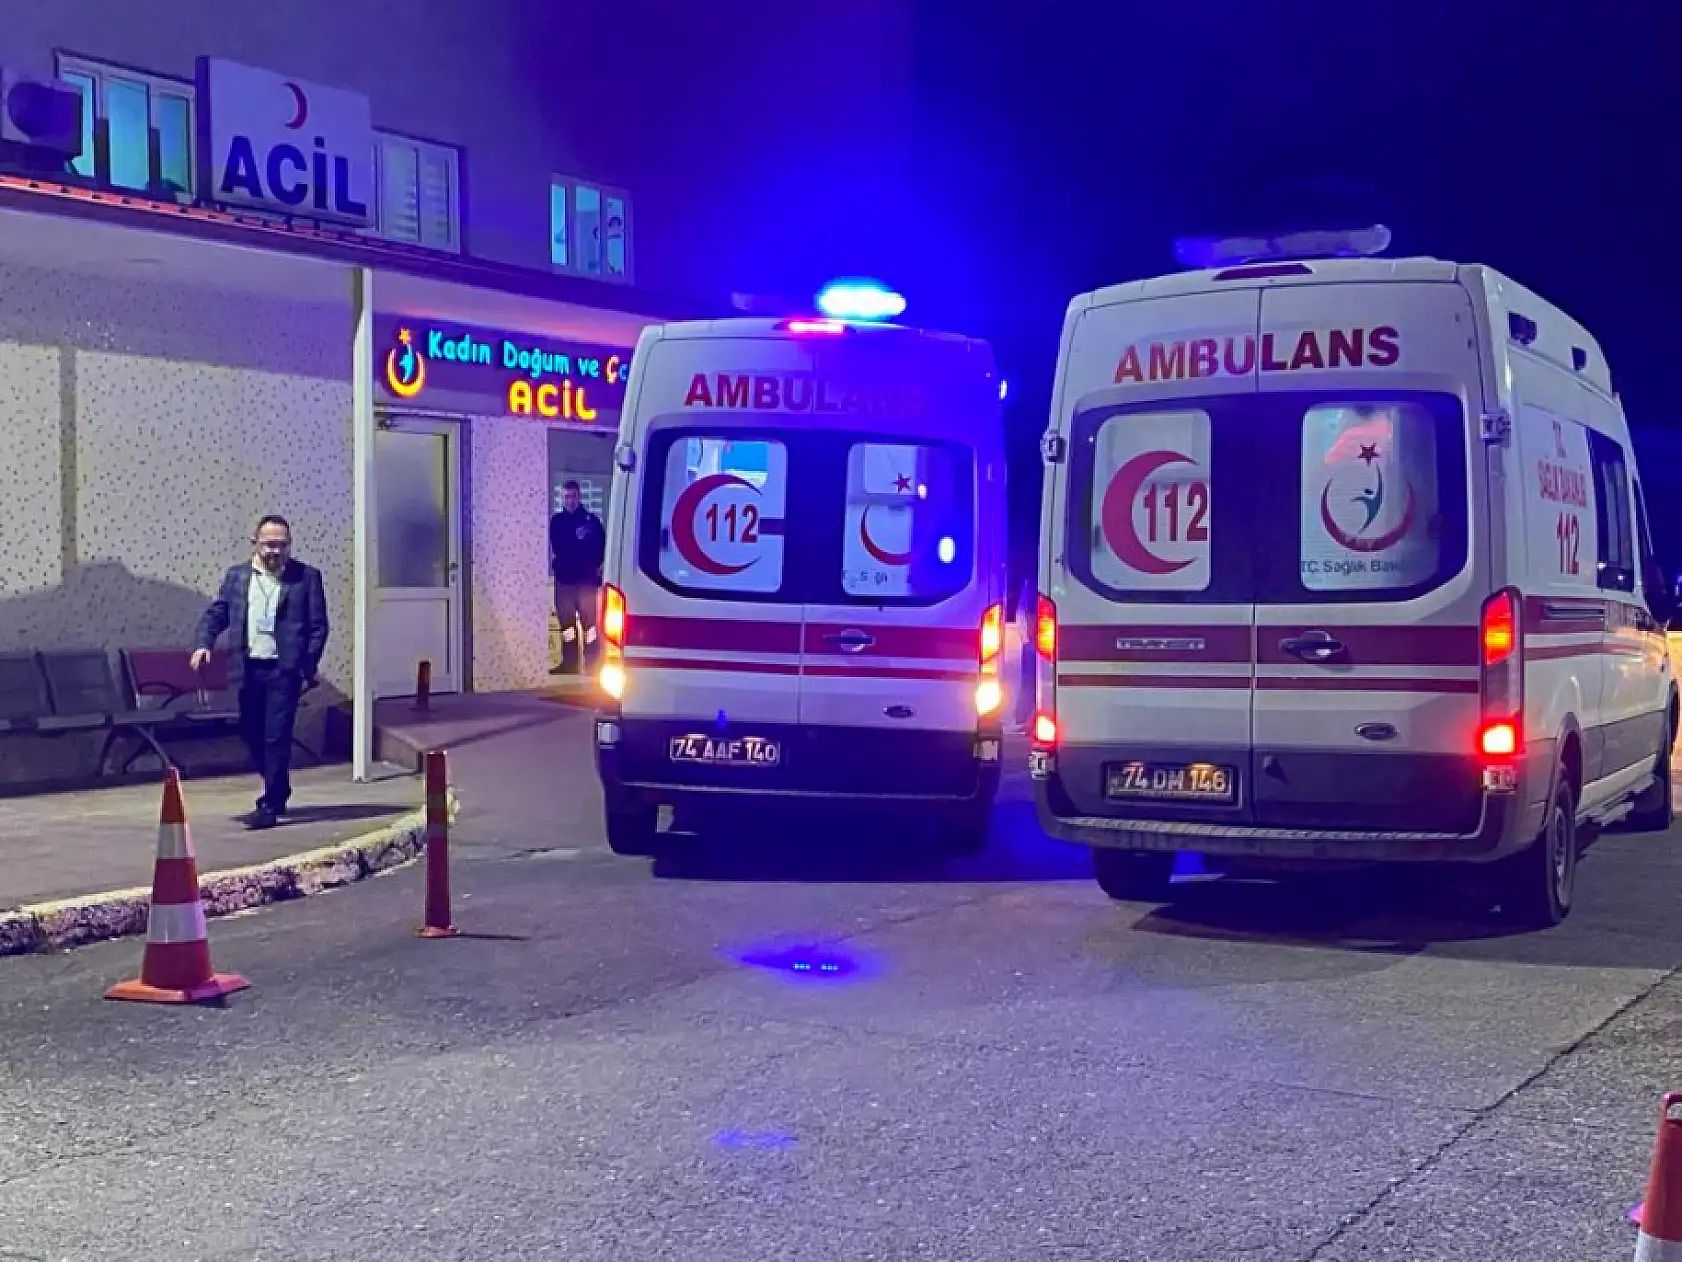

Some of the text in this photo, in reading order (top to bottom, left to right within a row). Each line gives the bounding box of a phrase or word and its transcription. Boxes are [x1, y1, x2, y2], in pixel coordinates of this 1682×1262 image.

[220, 134, 367, 217] ACİL
[427, 328, 491, 365] Kadın
[503, 340, 571, 379] Doğum
[577, 357, 600, 378] ve
[1113, 325, 1400, 384] AMBULANS
[508, 379, 597, 420] ACİL
[684, 372, 932, 416] AMBULA
[706, 503, 758, 543] 112
[1142, 482, 1209, 542] 112
[1556, 511, 1580, 575] 112
[673, 739, 776, 761] 74 AAF 140
[1122, 766, 1149, 789] 74
